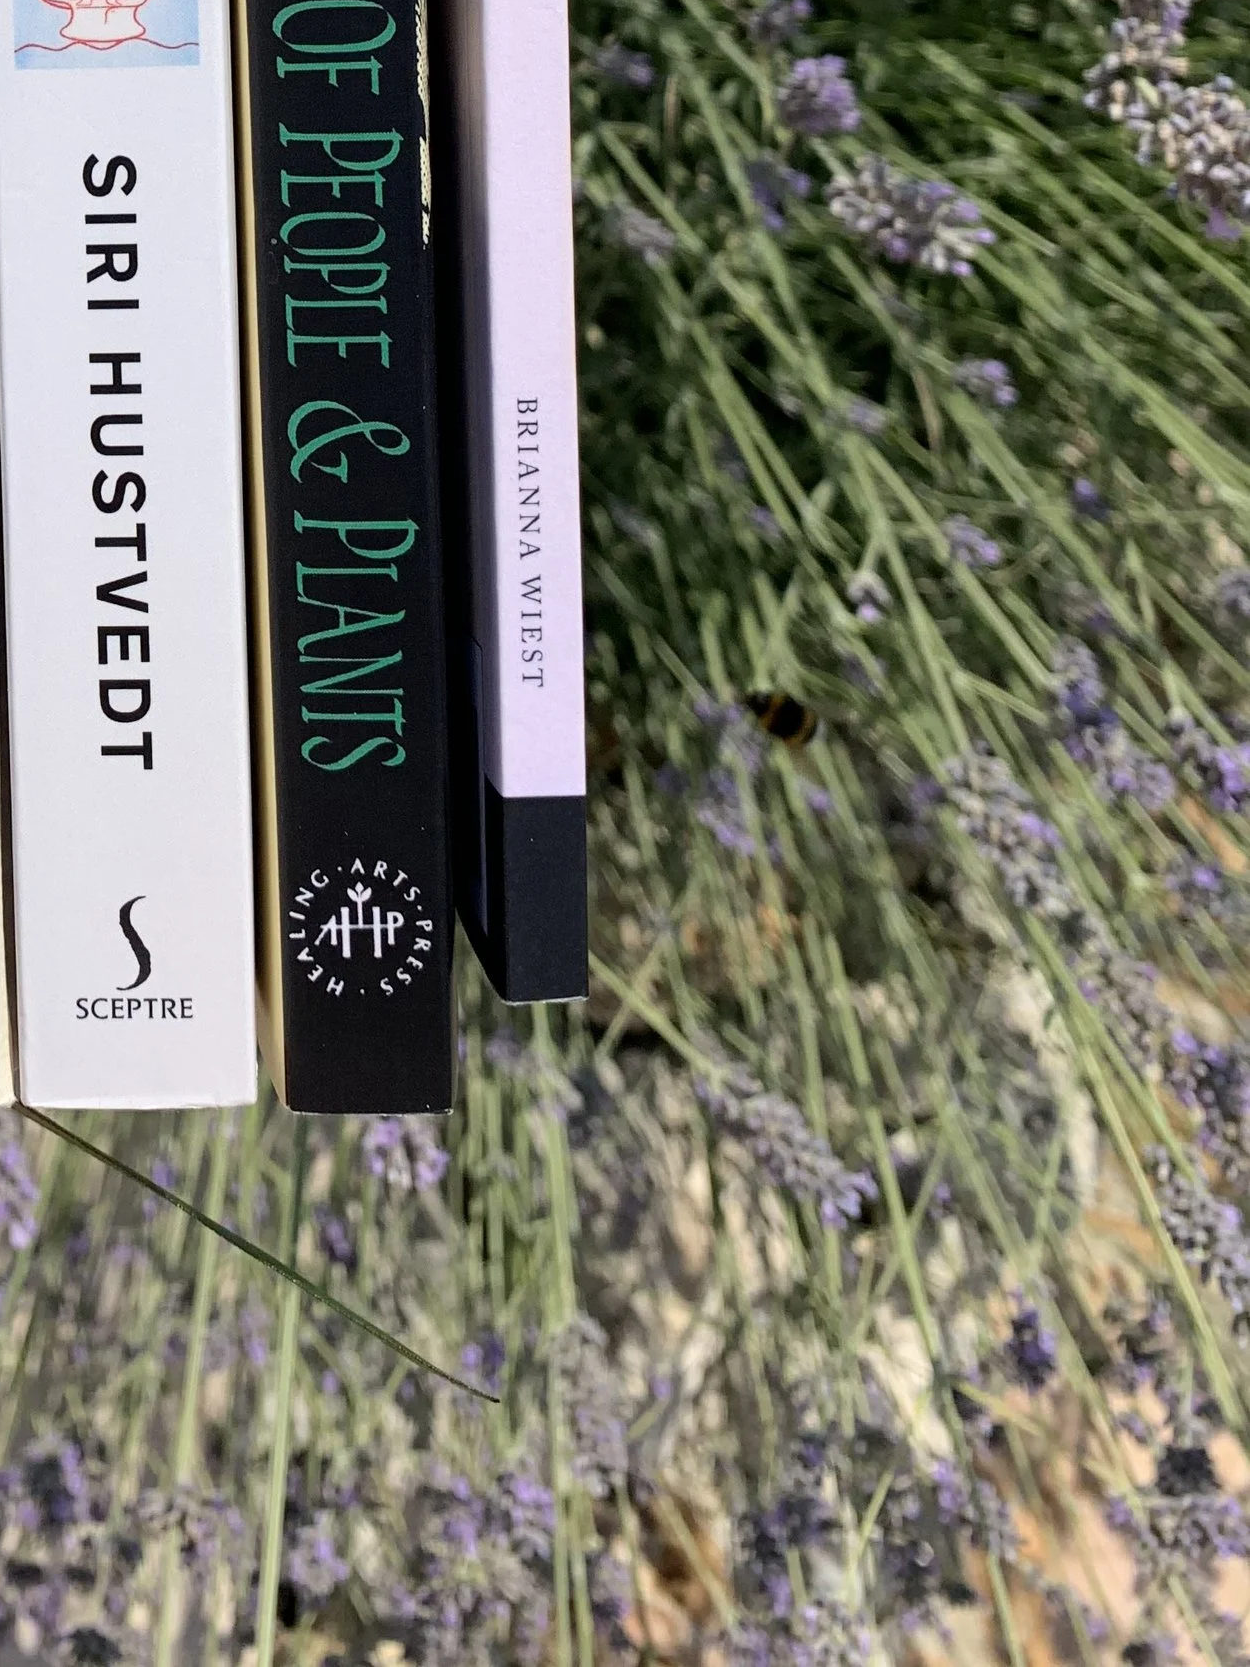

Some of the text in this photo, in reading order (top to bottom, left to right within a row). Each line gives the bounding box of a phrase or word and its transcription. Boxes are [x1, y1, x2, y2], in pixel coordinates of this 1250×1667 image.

[83, 154, 153, 770] SIRI HUSTVEDT
[273, 0, 419, 770] OF PEOPLE & PLANTS
[517, 399, 543, 687] BRIANNA WIEST
[77, 998, 193, 1019] SCEPTRE
[289, 857, 433, 996] HEALING ARTS PRESS
